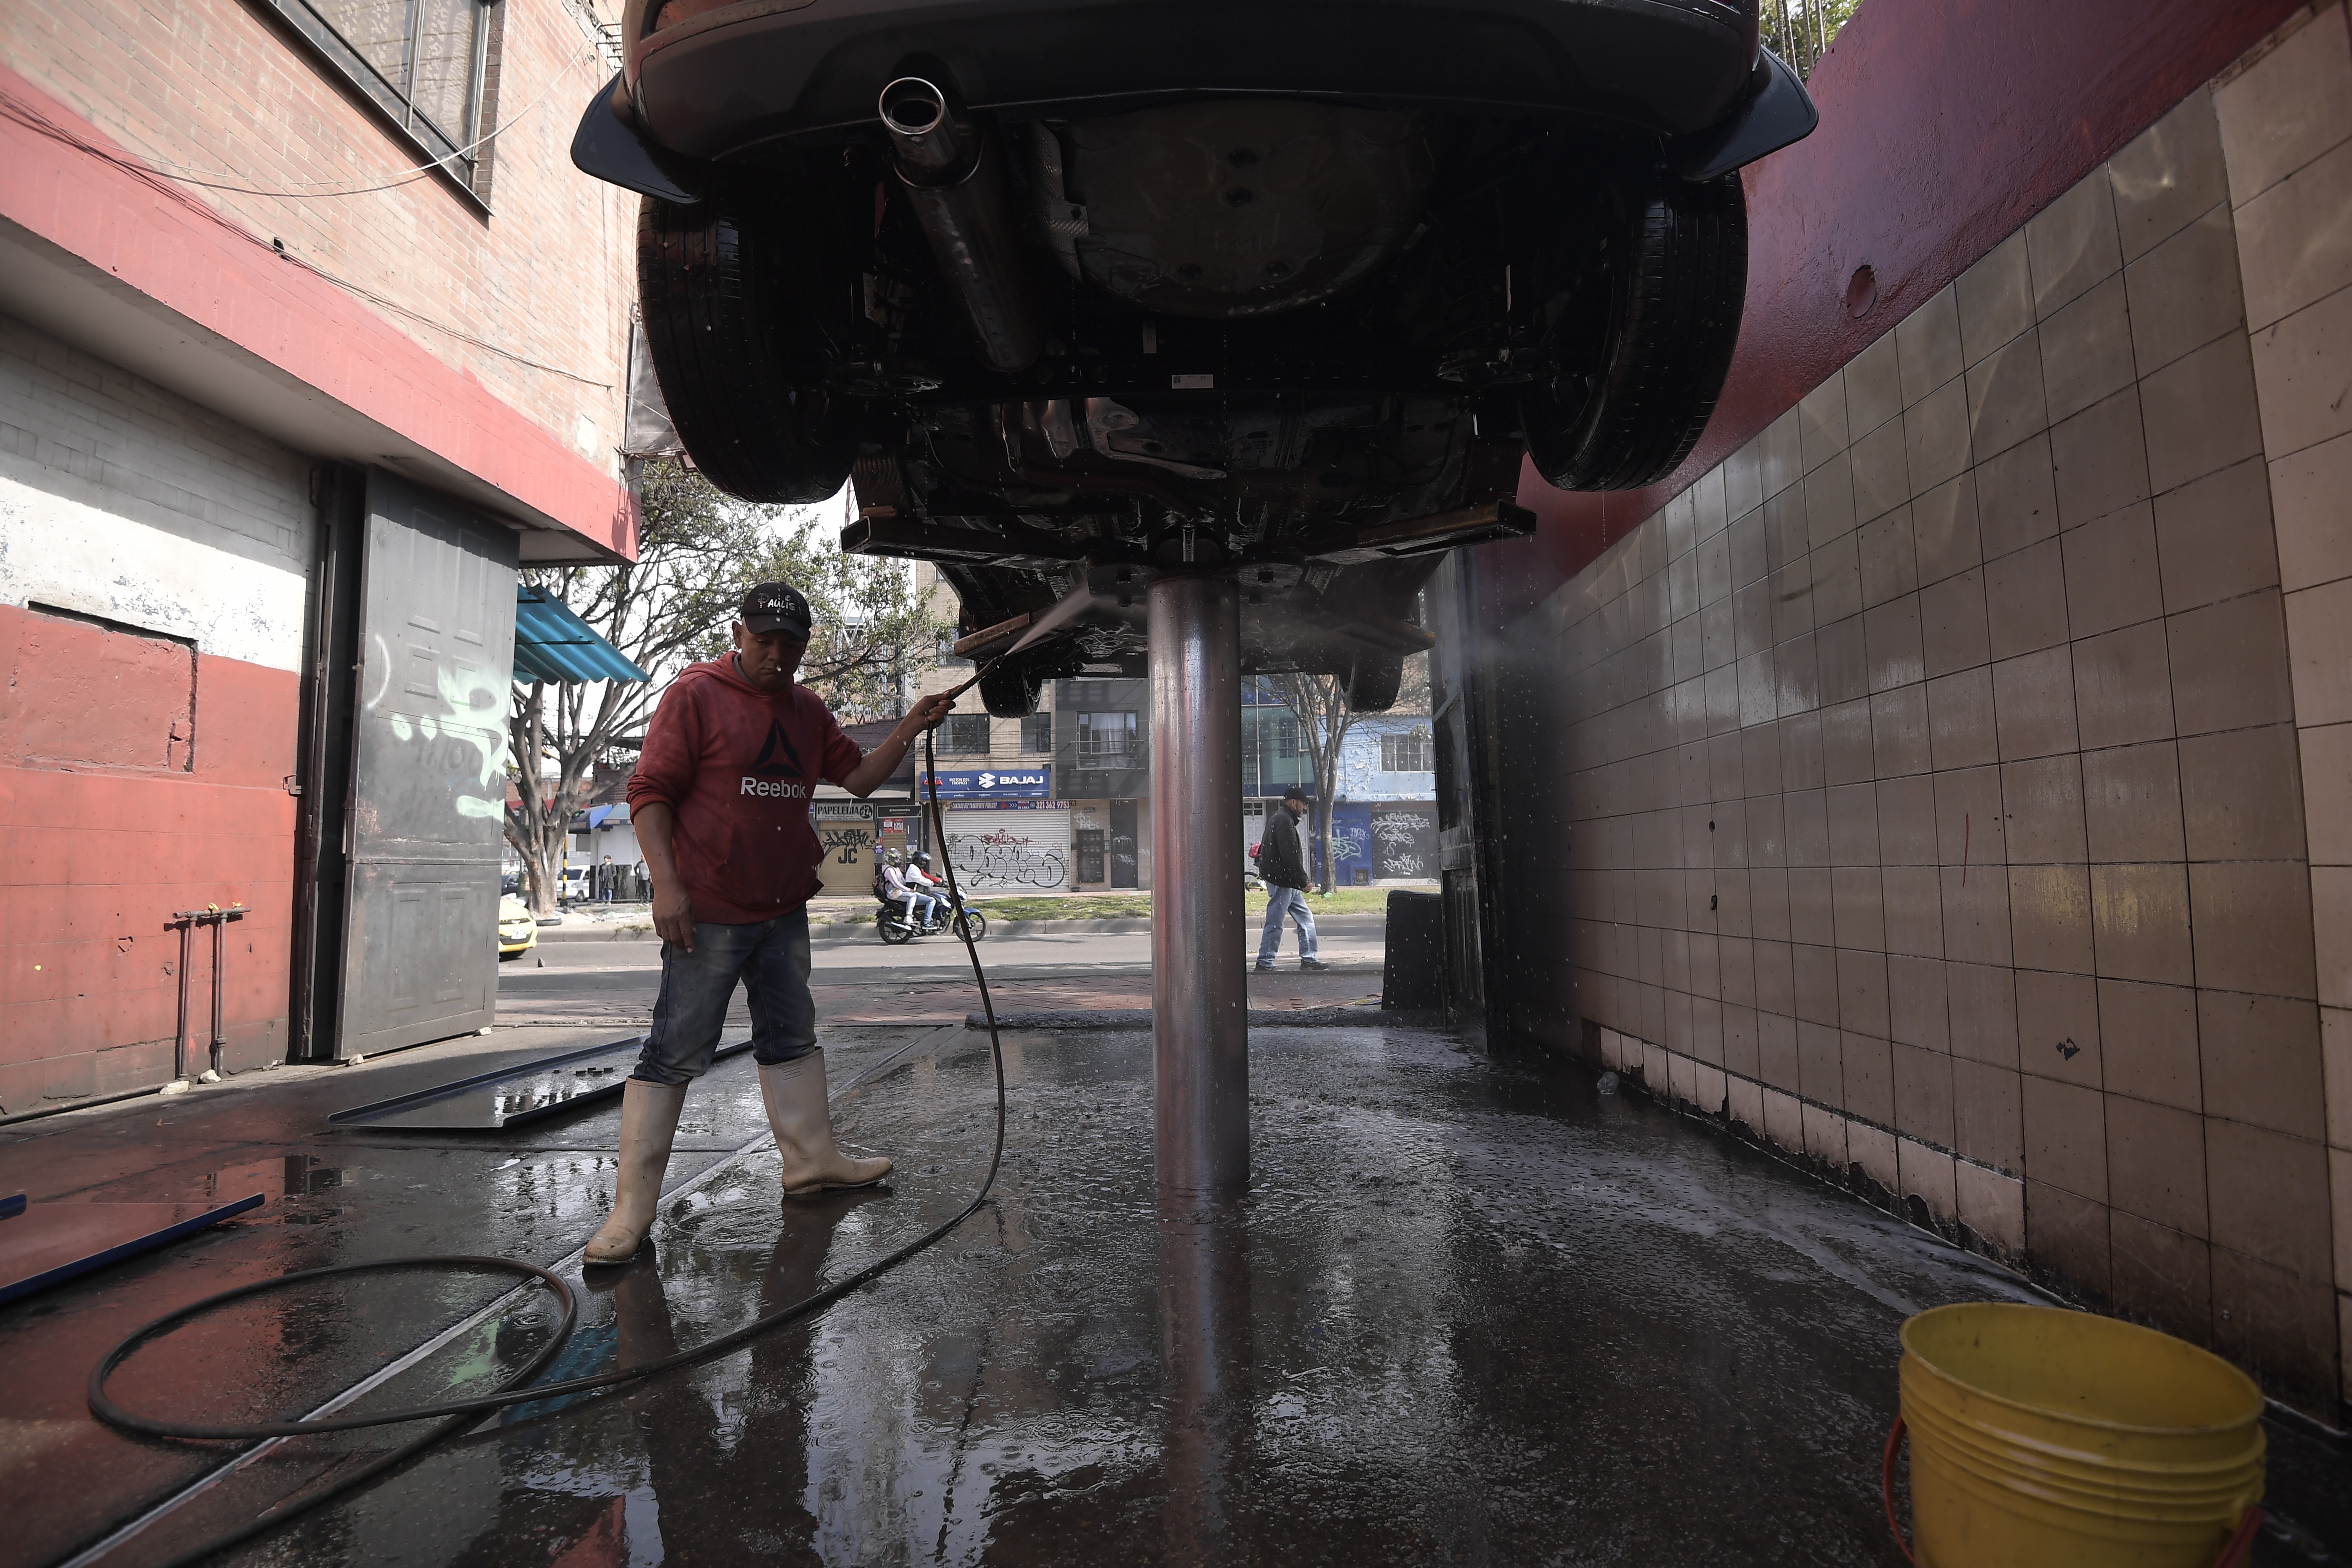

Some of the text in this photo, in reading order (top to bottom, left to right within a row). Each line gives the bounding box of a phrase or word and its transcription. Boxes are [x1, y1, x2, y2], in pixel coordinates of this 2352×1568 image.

[740, 777, 807, 798] Reebok
[999, 776, 1043, 784] BAJAJ
[838, 848, 857, 863] JC
